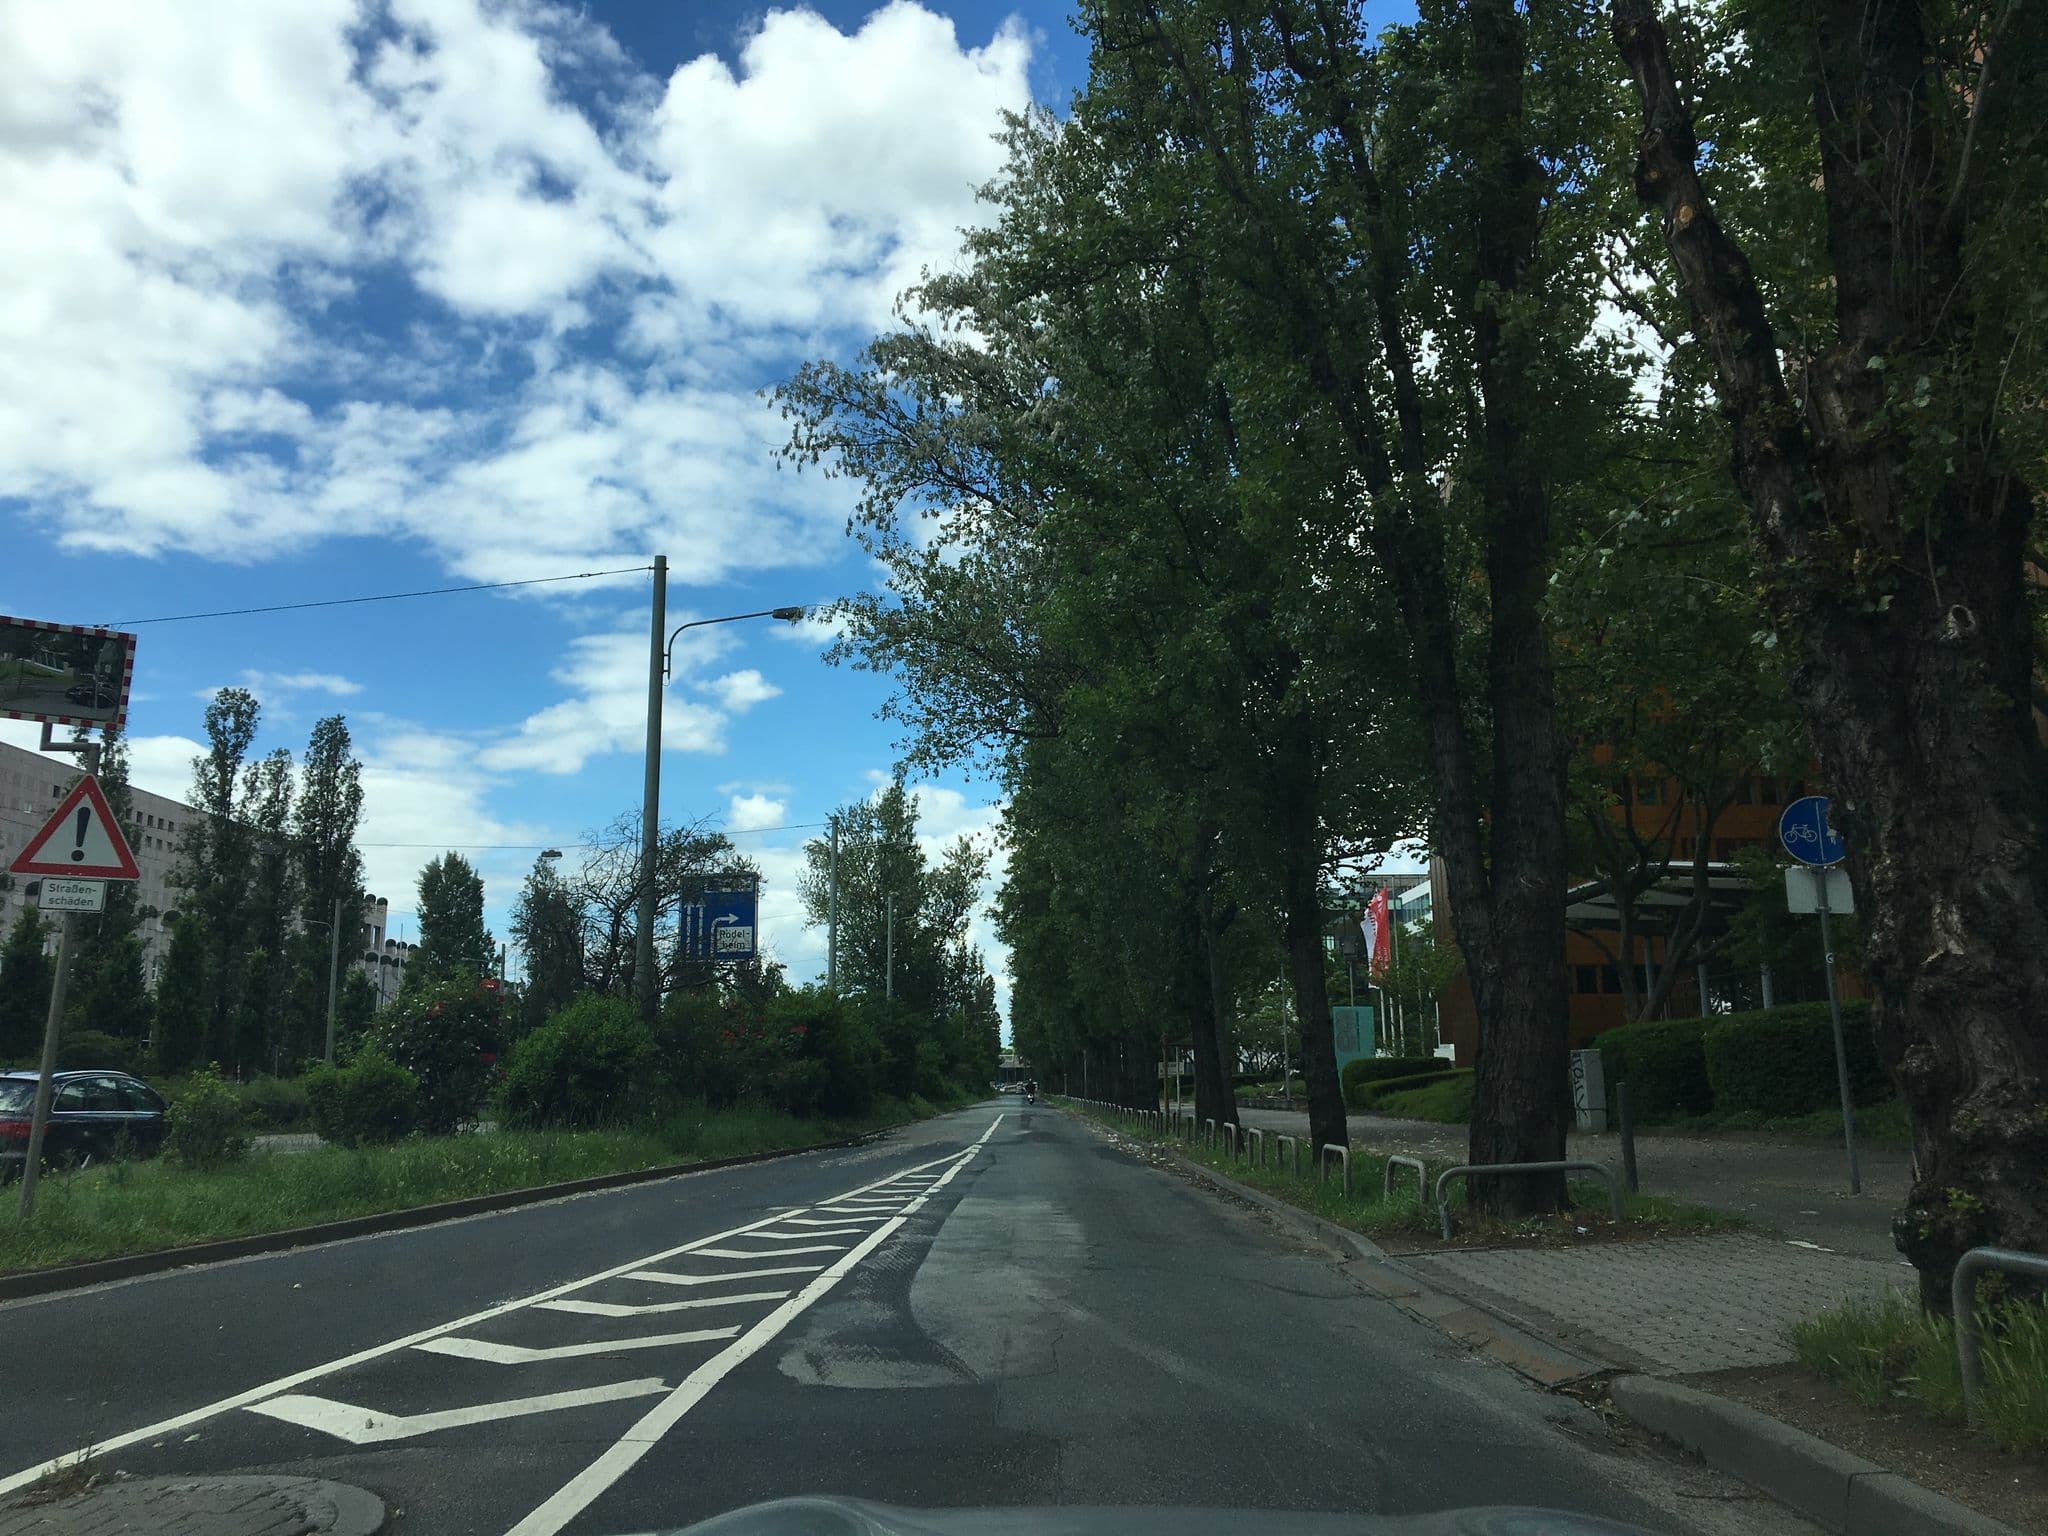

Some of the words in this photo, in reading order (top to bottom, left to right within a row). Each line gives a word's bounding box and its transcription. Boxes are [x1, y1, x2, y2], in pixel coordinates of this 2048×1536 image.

[48, 883, 97, 894] Straßen-
[48, 896, 94, 906] schäden
[719, 929, 750, 939] Rödel-
